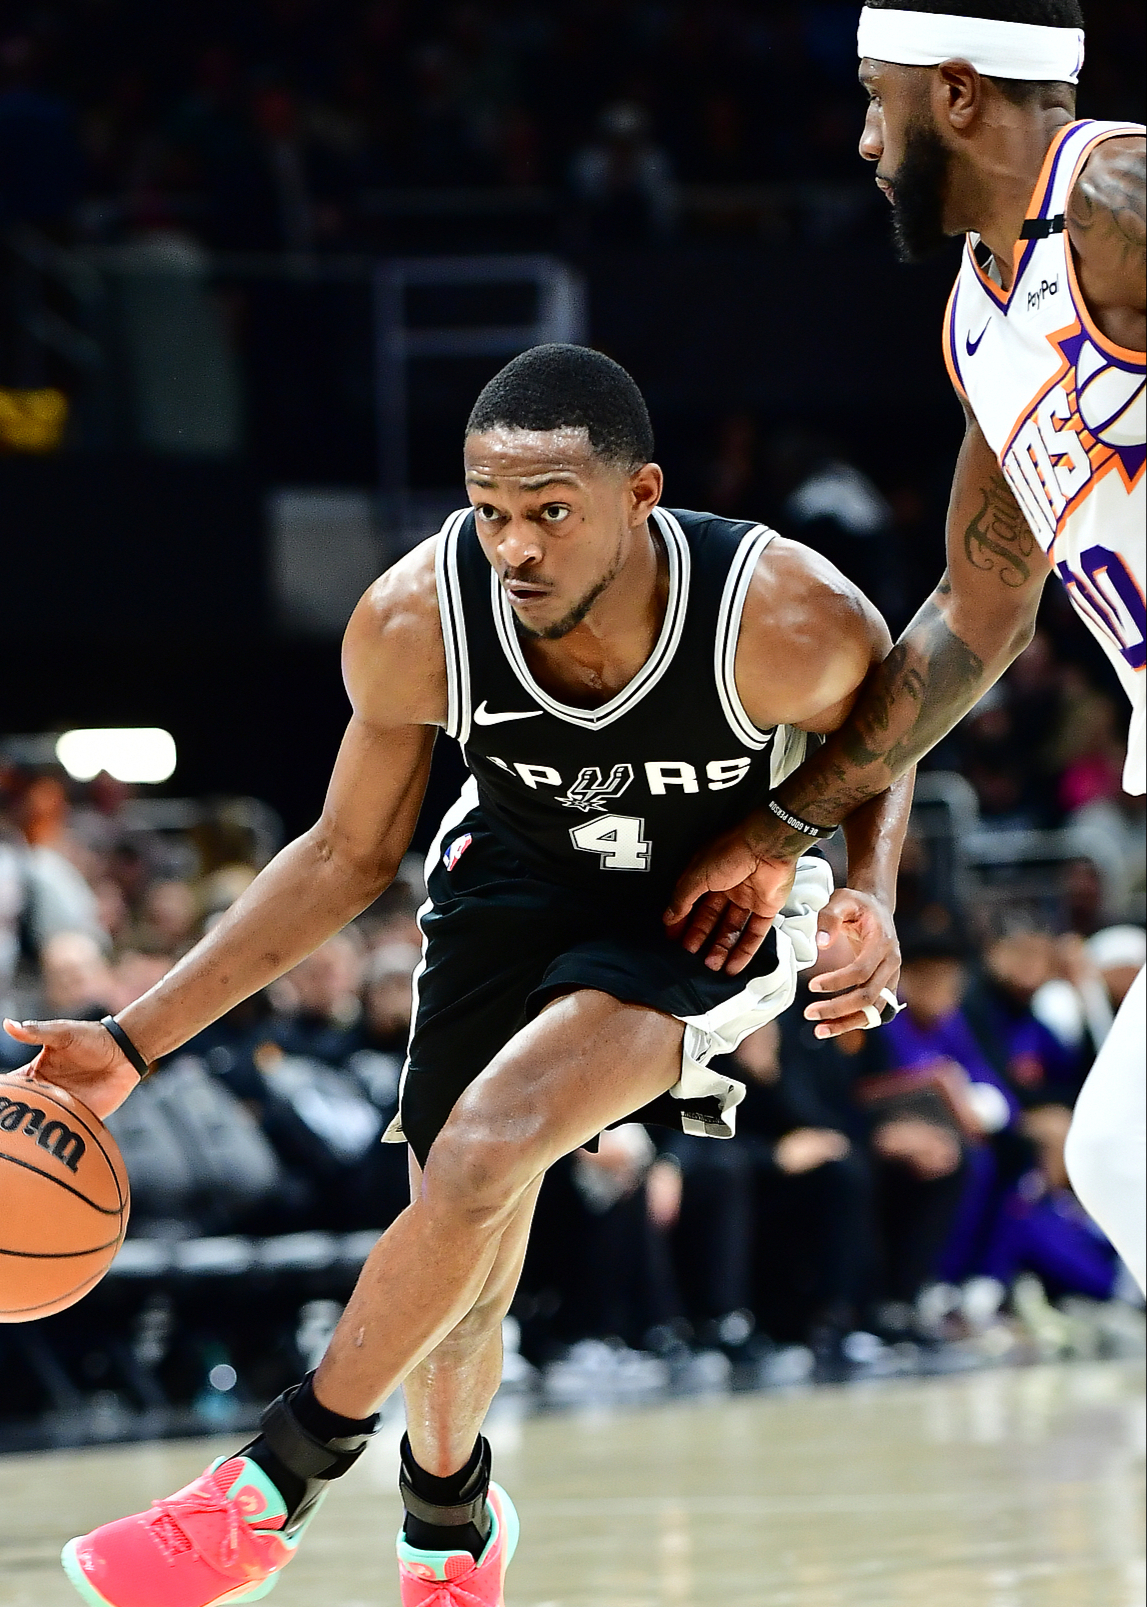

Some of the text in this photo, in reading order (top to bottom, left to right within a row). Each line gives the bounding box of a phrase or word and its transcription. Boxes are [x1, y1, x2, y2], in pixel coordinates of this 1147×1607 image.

[1027, 273, 1059, 312] PayPal
[1001, 383, 1093, 556] UNS
[486, 756, 752, 813] PURS
[568, 813, 653, 873] 4
[768, 800, 818, 836] BE A GOOD PERSON
